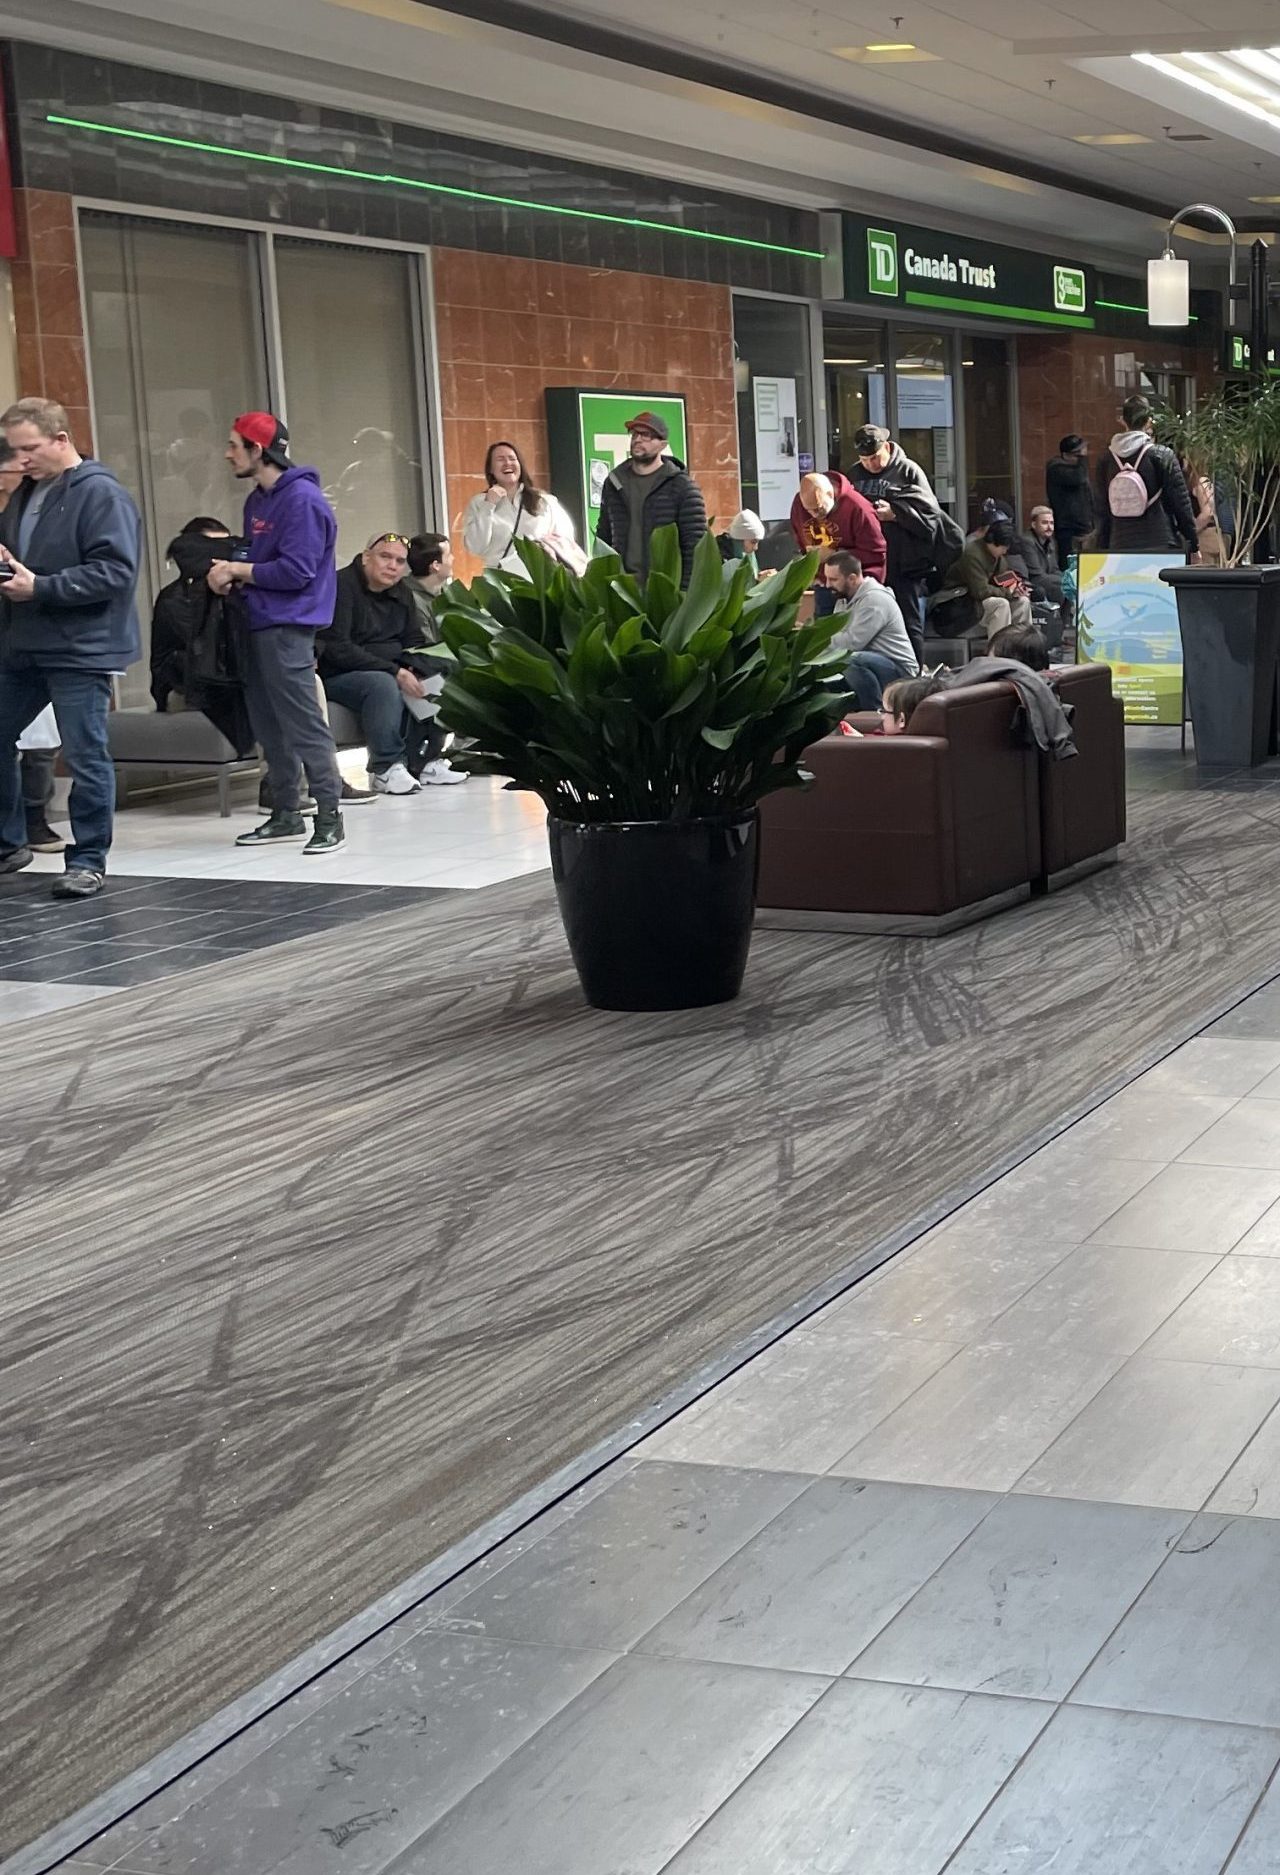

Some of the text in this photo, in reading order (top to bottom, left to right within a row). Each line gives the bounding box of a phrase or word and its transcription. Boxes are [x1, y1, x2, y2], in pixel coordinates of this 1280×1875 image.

[871, 241, 996, 289] TD Canada Trust
